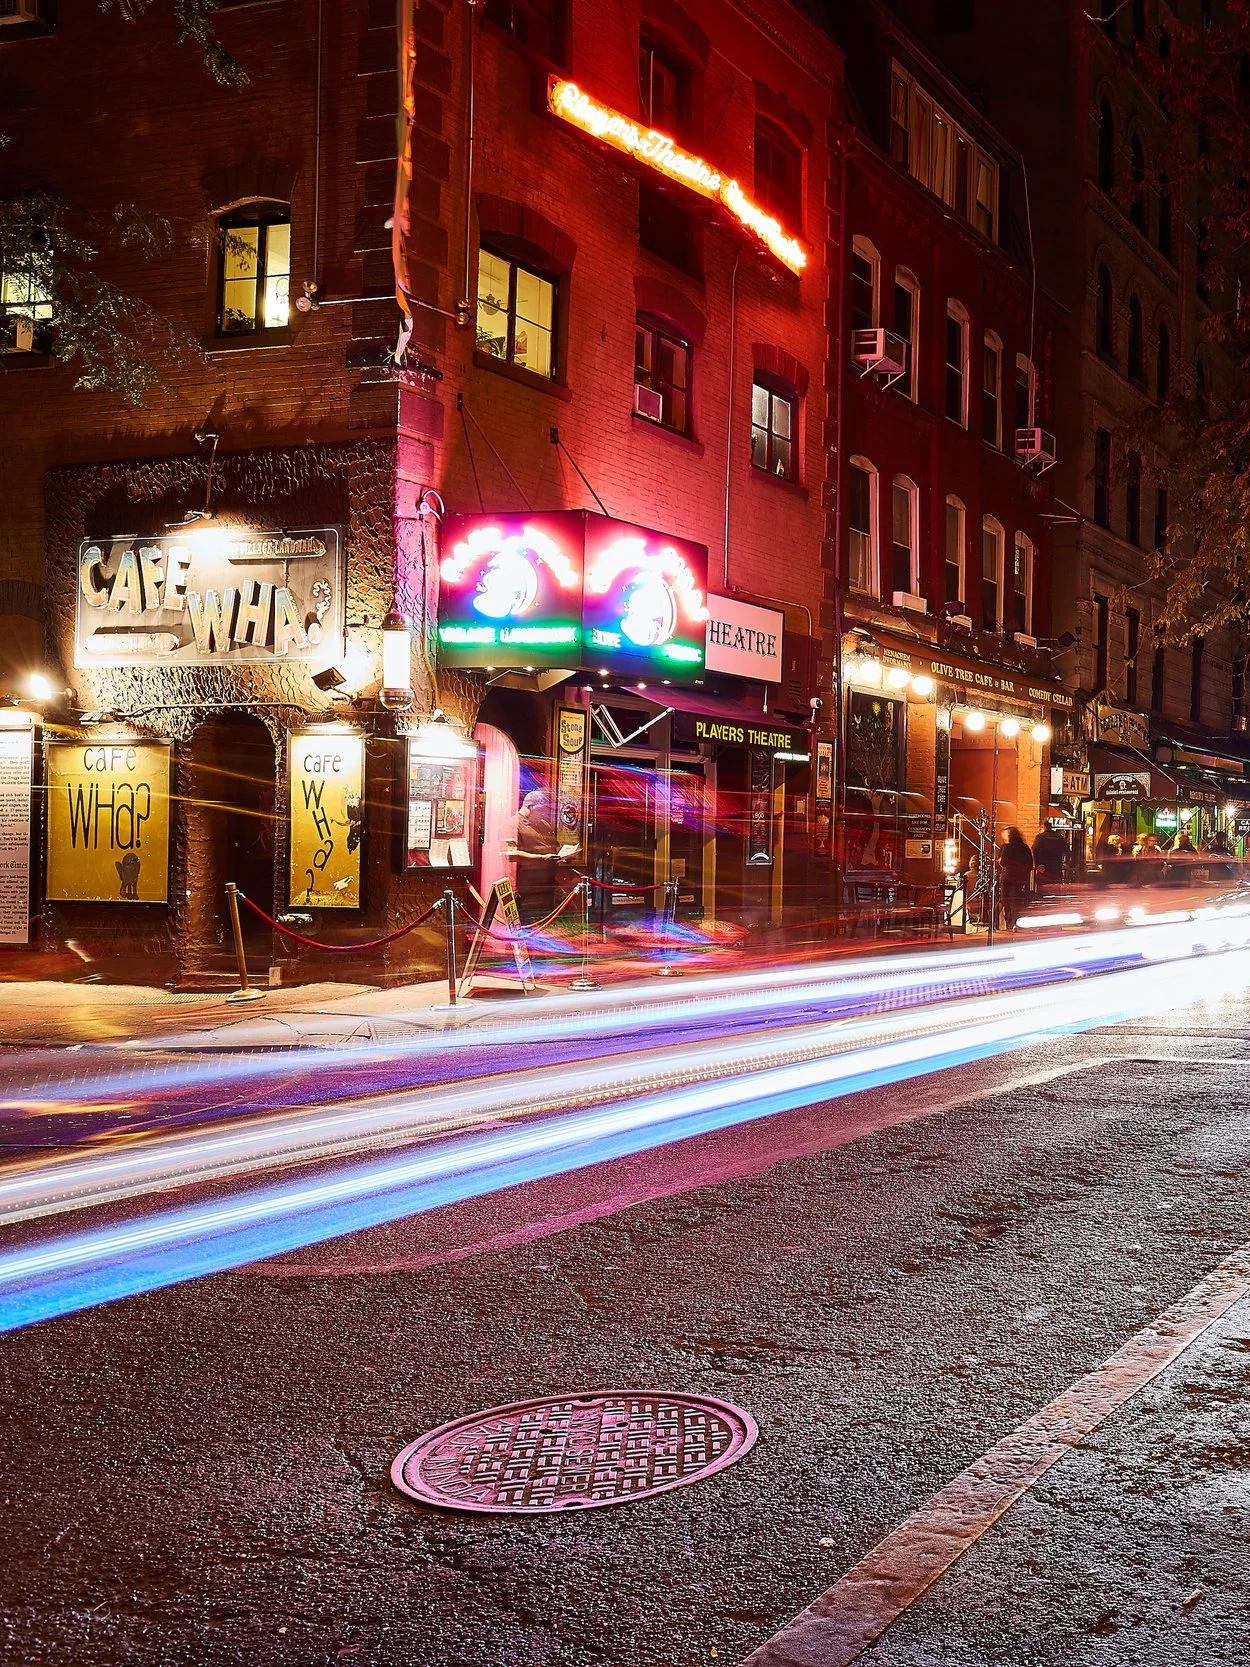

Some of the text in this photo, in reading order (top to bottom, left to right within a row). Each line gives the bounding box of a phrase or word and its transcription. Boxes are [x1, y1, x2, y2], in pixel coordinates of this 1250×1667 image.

[80, 545, 193, 614] CAFE
[187, 577, 332, 657] WHA?
[708, 619, 778, 658] HEATRE
[931, 661, 953, 678] OLIVE
[955, 668, 974, 683] TREE
[975, 672, 993, 687] CAFE
[1001, 679, 1015, 693] BAR
[1028, 687, 1052, 702] COMEDY
[1052, 692, 1074, 707] CELLAR
[561, 719, 583, 734] Stone
[696, 721, 792, 749] PLAYERS THEATRE
[1070, 773, 1087, 792] ATM
[1048, 817, 1067, 827] ATM
[560, 1448, 596, 1492] SEWER
